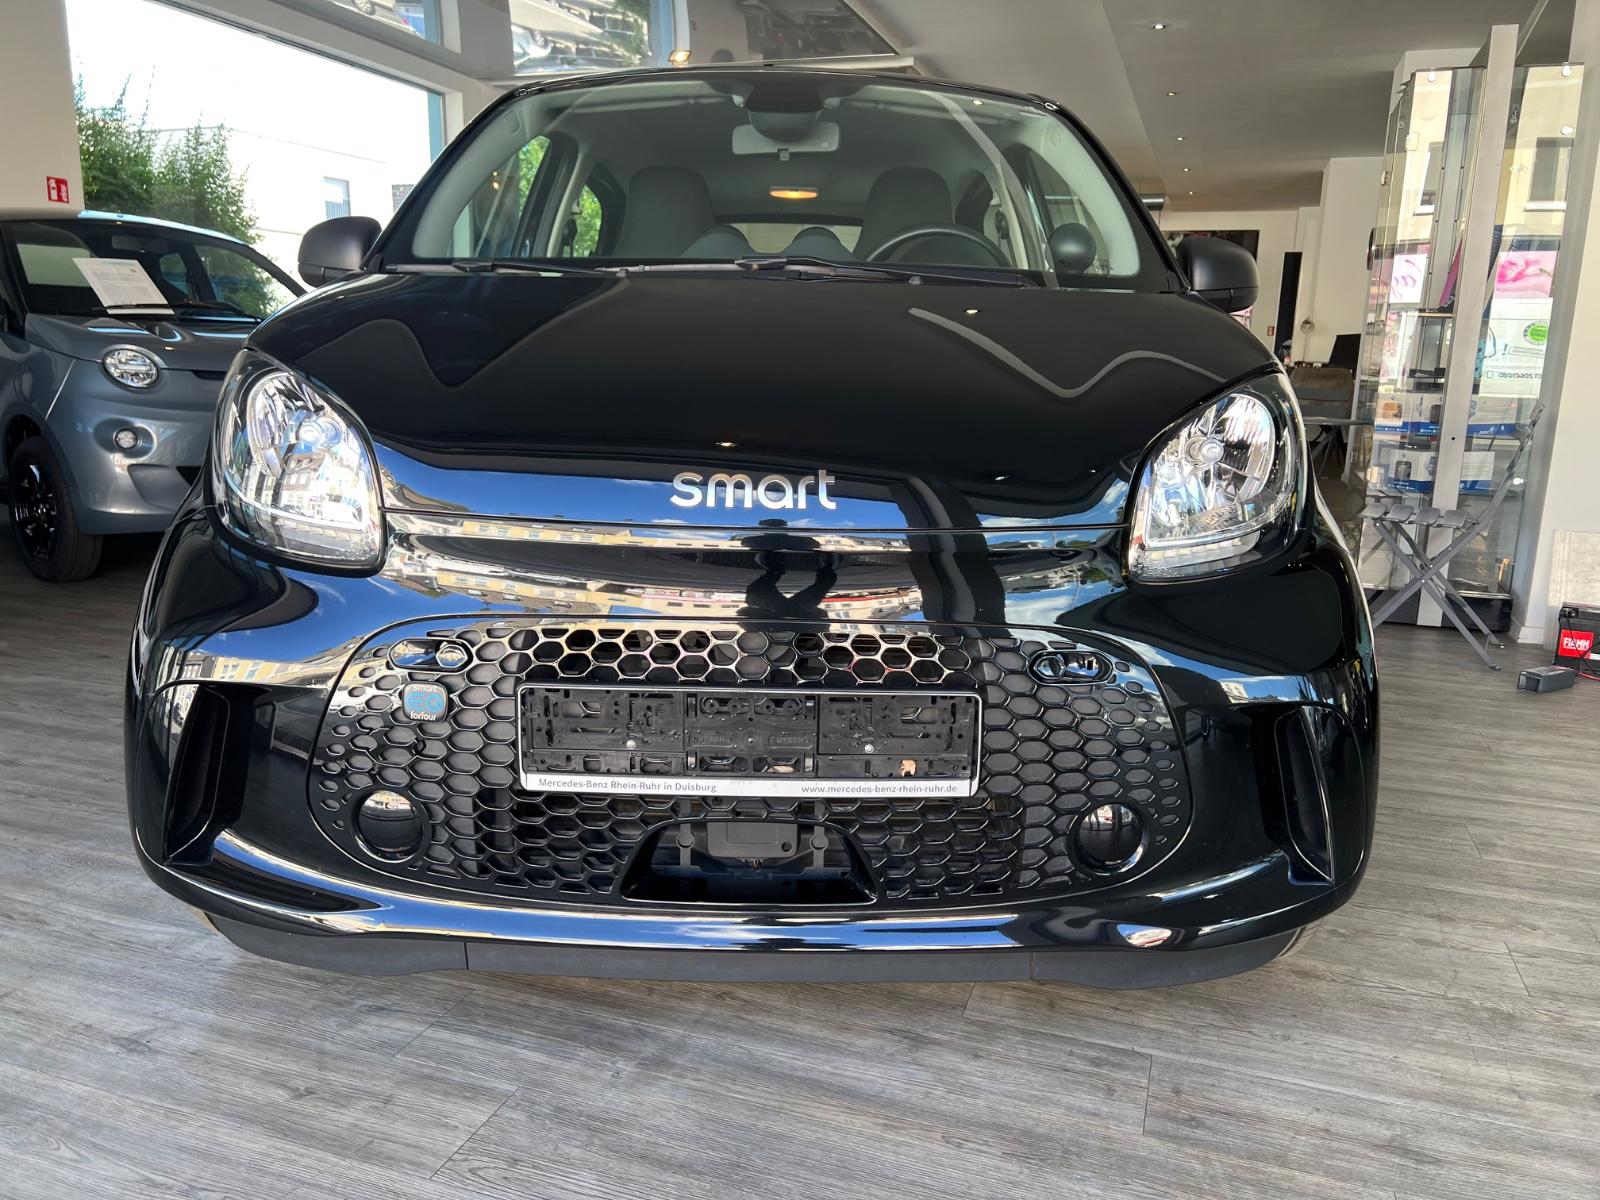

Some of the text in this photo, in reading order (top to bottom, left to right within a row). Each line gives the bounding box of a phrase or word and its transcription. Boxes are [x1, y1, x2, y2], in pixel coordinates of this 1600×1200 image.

[670, 469, 837, 510] smart
[1563, 637, 1590, 650] FIAMM
[410, 710, 437, 721] forfour
[538, 778, 717, 793] Mercedes-Benz Rhein-Ruhr in Duisburg
[801, 784, 958, 793] www.mercedes-benz-rhein-ruhr.de
